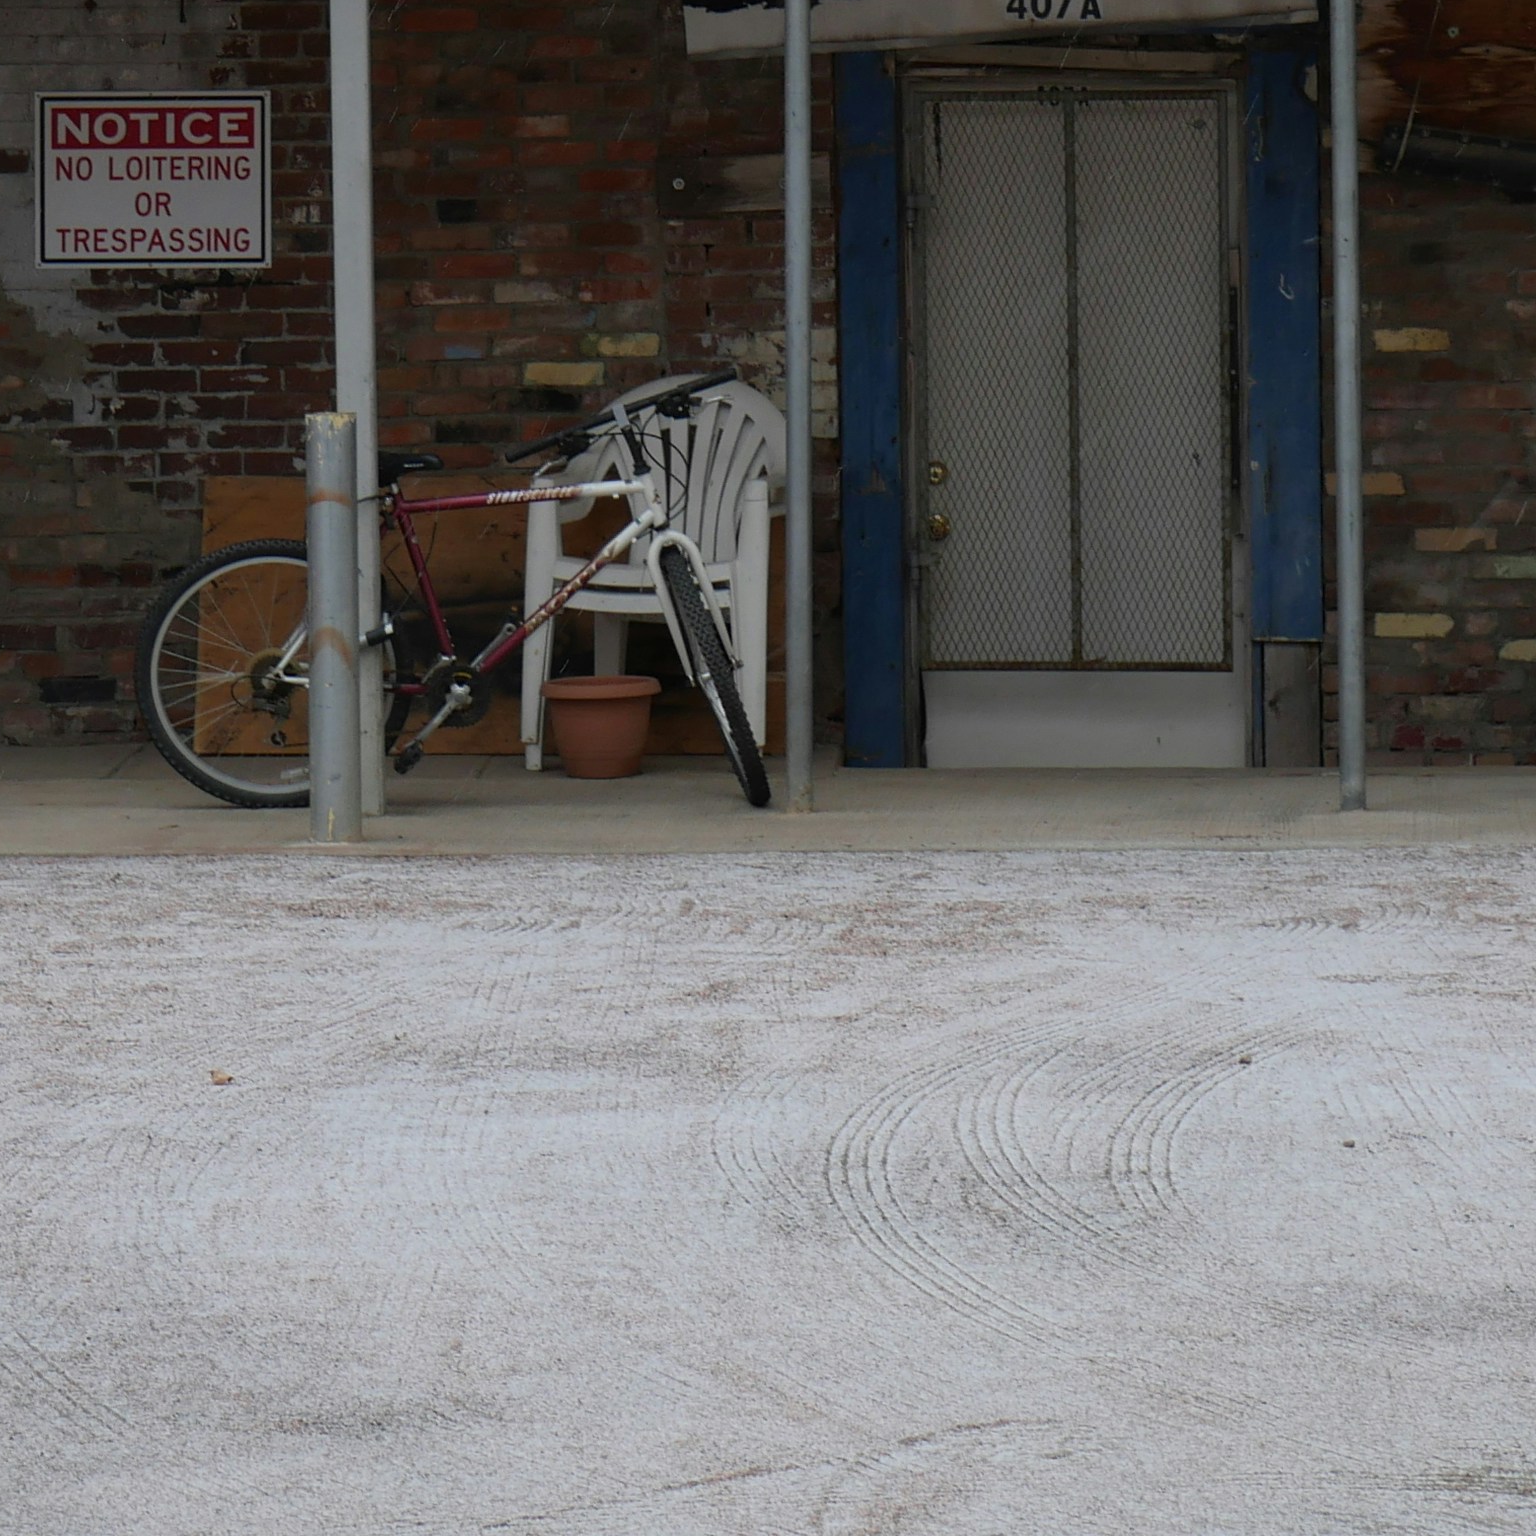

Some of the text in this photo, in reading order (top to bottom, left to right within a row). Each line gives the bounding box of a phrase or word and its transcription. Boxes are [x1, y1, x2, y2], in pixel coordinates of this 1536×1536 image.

[56, 111, 250, 145] NOTICE
[55, 155, 251, 181] NO LOITERING
[134, 192, 172, 217] OR
[56, 227, 251, 253] TRESPASSING
